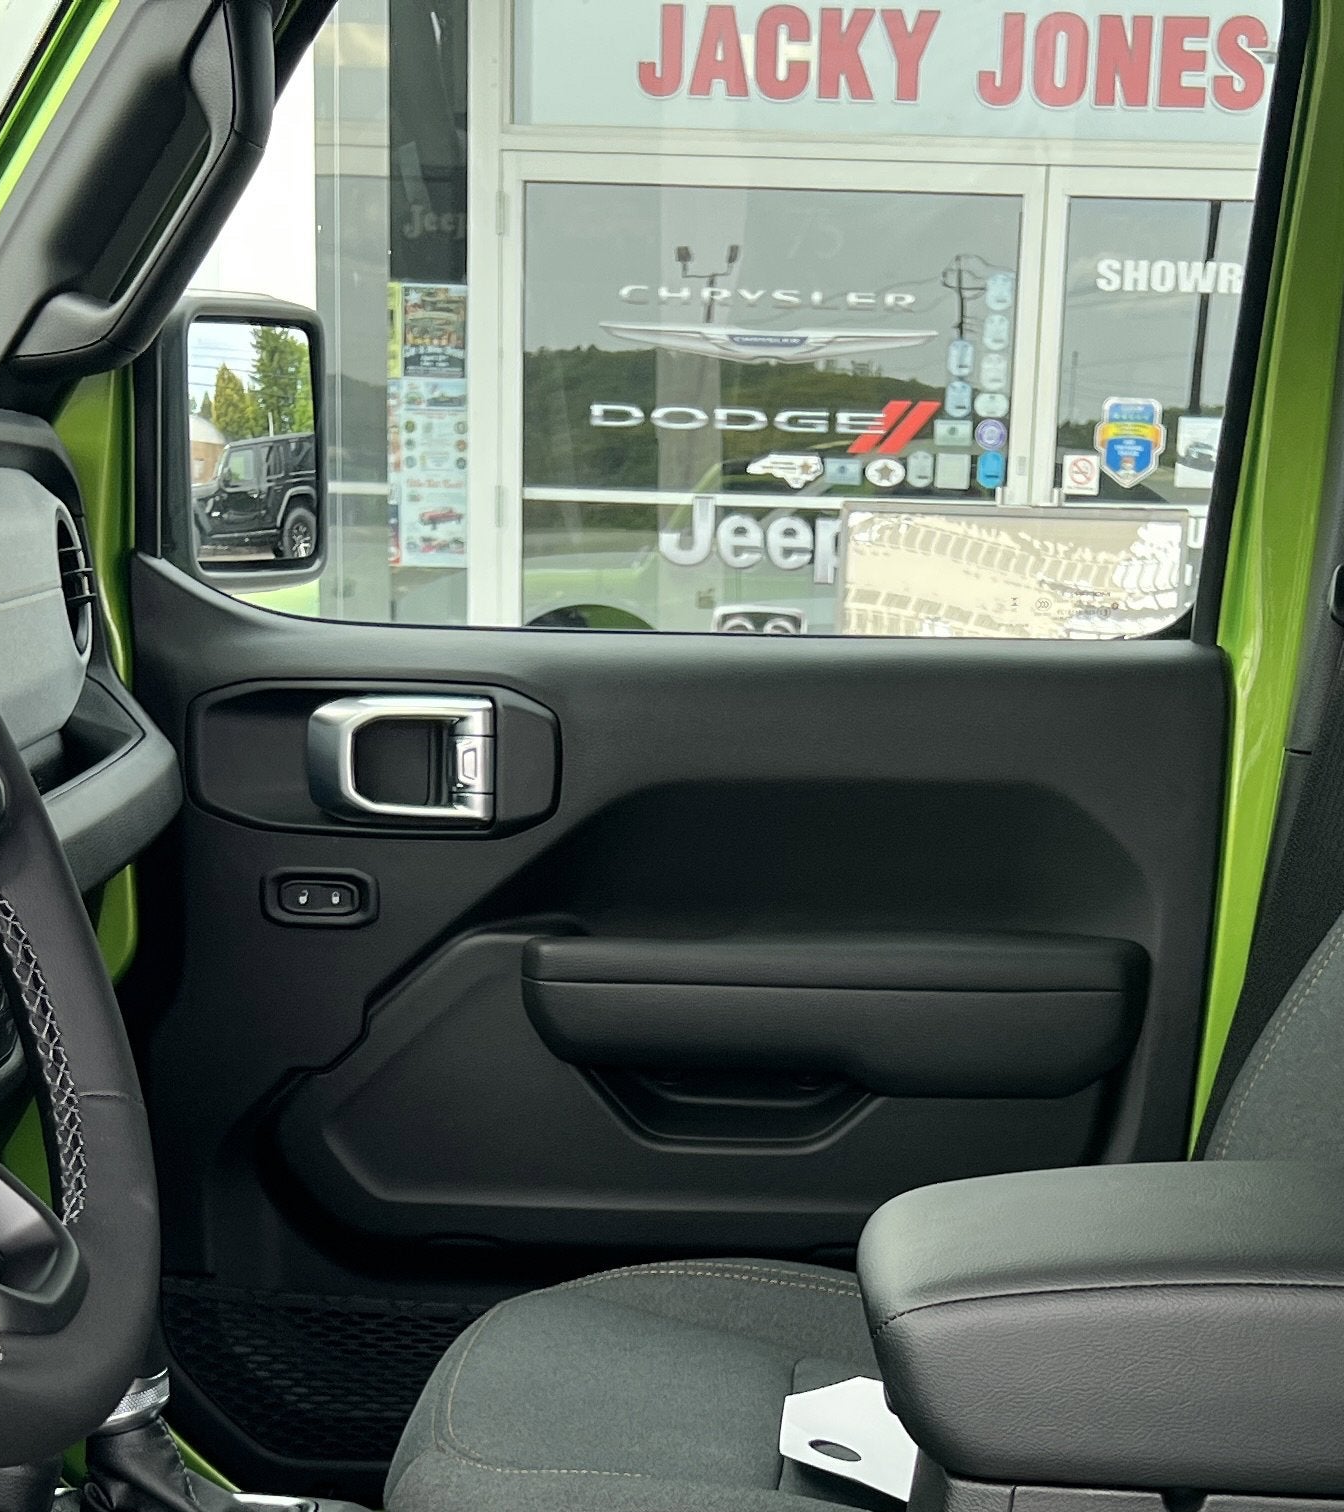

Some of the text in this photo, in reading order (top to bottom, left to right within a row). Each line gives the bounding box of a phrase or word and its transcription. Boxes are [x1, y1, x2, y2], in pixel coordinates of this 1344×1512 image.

[638, 3, 1270, 110] JACKY JONES
[1096, 258, 1245, 294] SHOWR
[618, 284, 918, 307] CHRYSLER
[590, 402, 887, 434] DODGE
